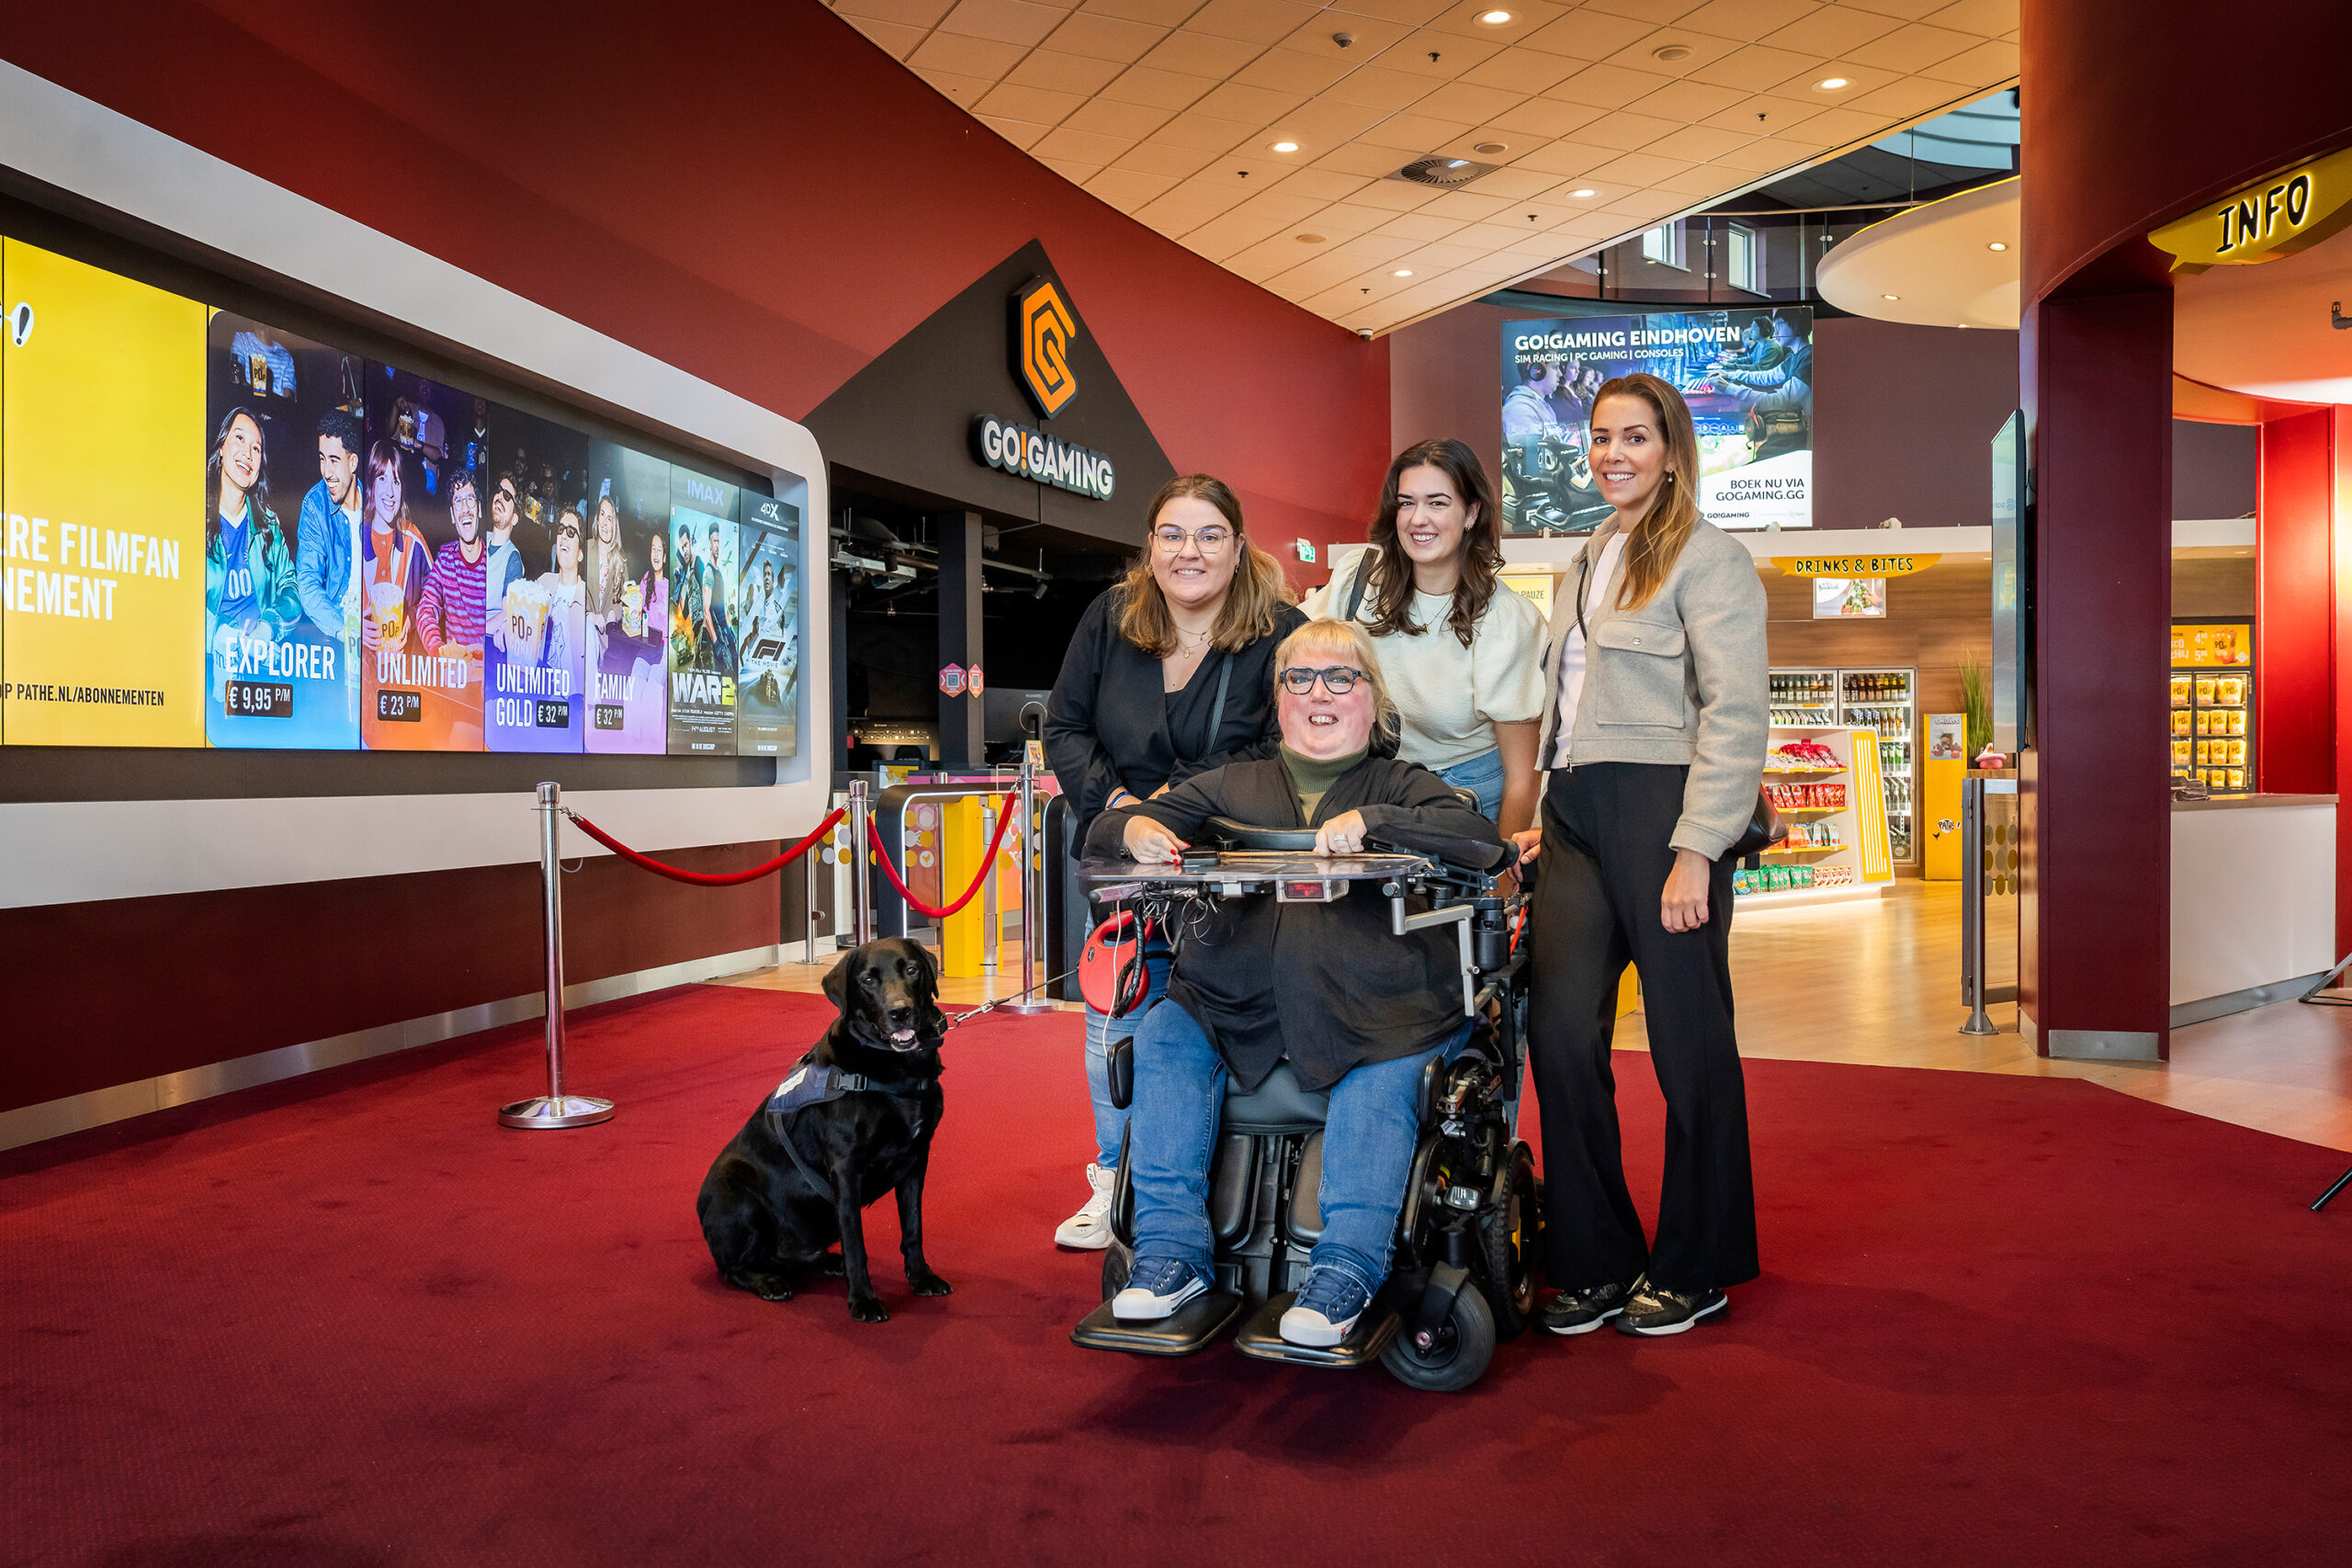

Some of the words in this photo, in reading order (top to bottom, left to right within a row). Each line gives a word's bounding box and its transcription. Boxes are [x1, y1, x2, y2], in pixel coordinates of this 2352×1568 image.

[2215, 175, 2312, 254] INFO
[1515, 332, 1626, 351] GO!GAMING
[1630, 326, 1740, 346] EINDHOVEN
[1515, 354, 1532, 364] SIM
[1532, 353, 1568, 363] RACING
[1575, 352, 1589, 361] PC
[1589, 350, 1627, 360] GAMING
[1634, 348, 1684, 359] CONSOLES
[984, 420, 1114, 496] GO!GAMING
[686, 478, 725, 507] IMAX
[1715, 490, 1804, 502] GOGAMING.GG
[1730, 479, 1762, 490] BOEK
[1765, 479, 1782, 489] NU
[1785, 478, 1804, 488] VIA
[61, 522, 179, 580] FILMFAN
[1796, 559, 1849, 573] DRINKS
[1854, 558, 1866, 572] &
[1871, 558, 1913, 571] BITES
[225, 637, 336, 681] EXPLORER
[377, 651, 468, 690] UNLIMITED
[496, 662, 571, 696] UNLIMITED
[594, 672, 636, 702] FAMILY
[17, 683, 164, 706] PATHE.NL/ABONNEMENTEN
[229, 686, 238, 709] €
[243, 686, 272, 714] 9,95
[275, 688, 290, 703] P/M
[379, 694, 388, 716] €
[390, 695, 404, 716] 23
[406, 694, 420, 709] P/M
[496, 697, 533, 728] GOLD
[537, 705, 544, 723] €
[545, 705, 557, 723] 32
[558, 705, 569, 717] P/M
[596, 708, 602, 725] €
[603, 708, 613, 726] 32
